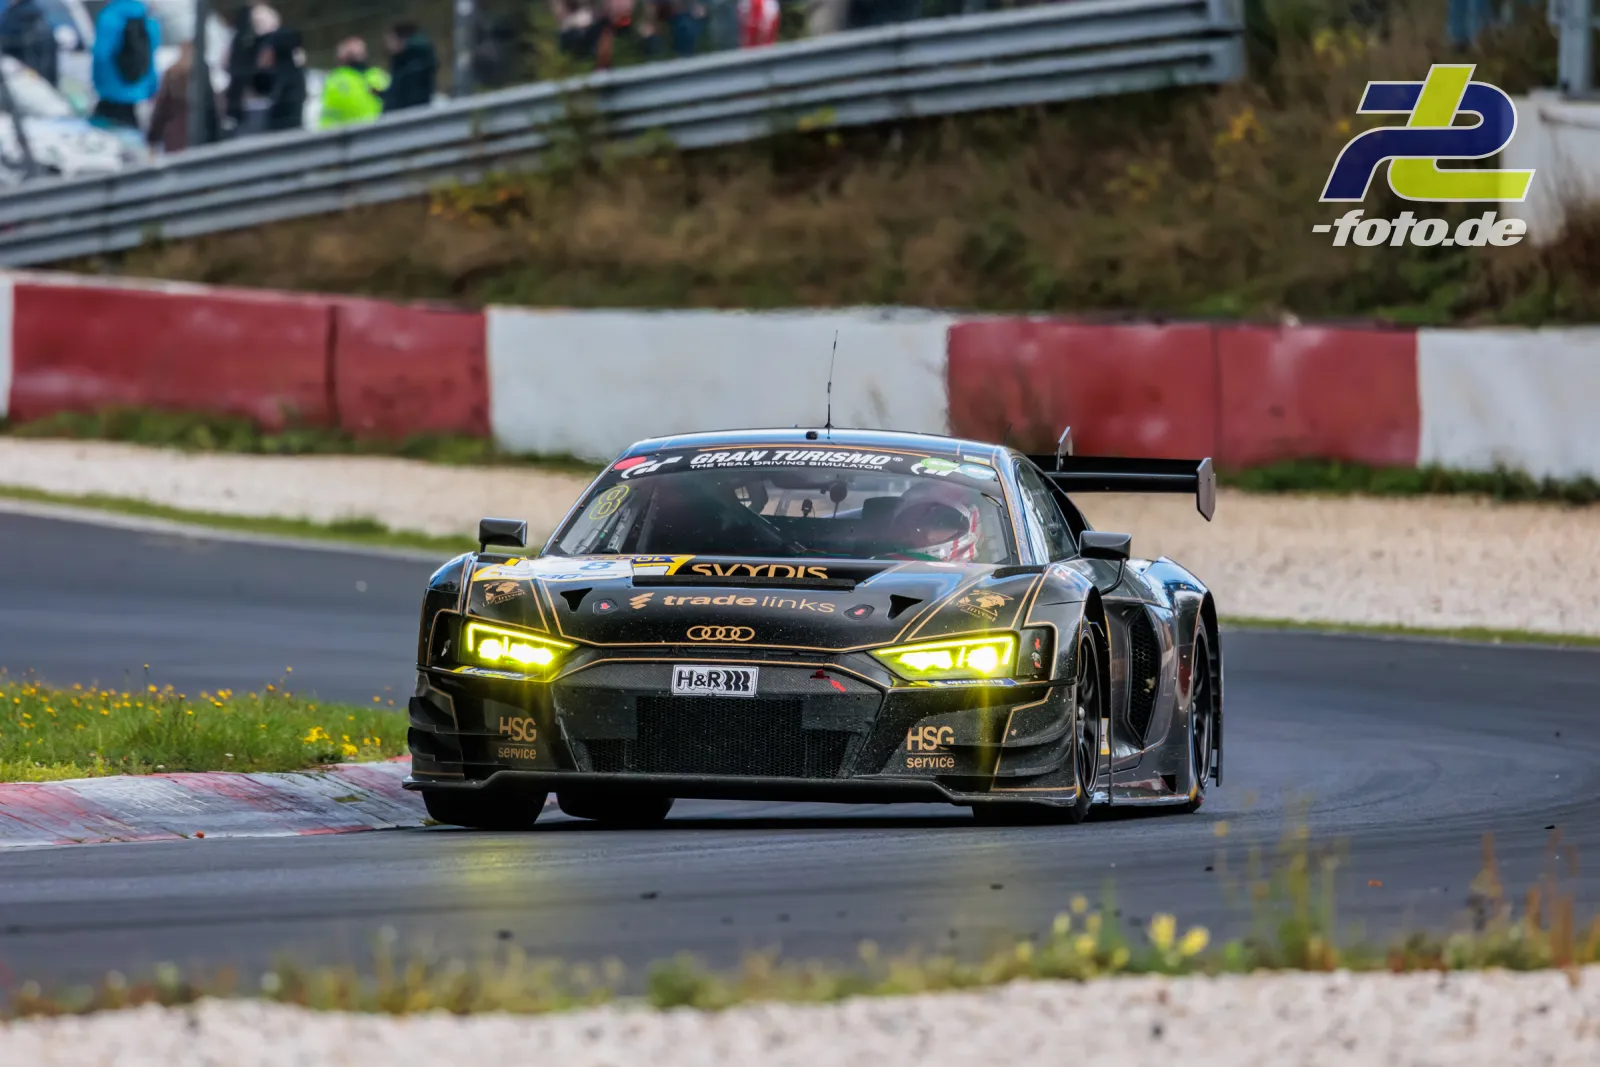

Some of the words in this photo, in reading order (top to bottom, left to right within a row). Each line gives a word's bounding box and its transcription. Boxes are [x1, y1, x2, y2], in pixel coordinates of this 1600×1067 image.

[690, 450, 768, 465] GRAN
[808, 461, 883, 471] SIMULATOR
[589, 484, 630, 521] 8
[676, 669, 724, 691] H&R
[499, 716, 537, 742] HSG
[907, 726, 955, 751] HSG
[498, 746, 537, 760] service
[906, 756, 955, 769] service
